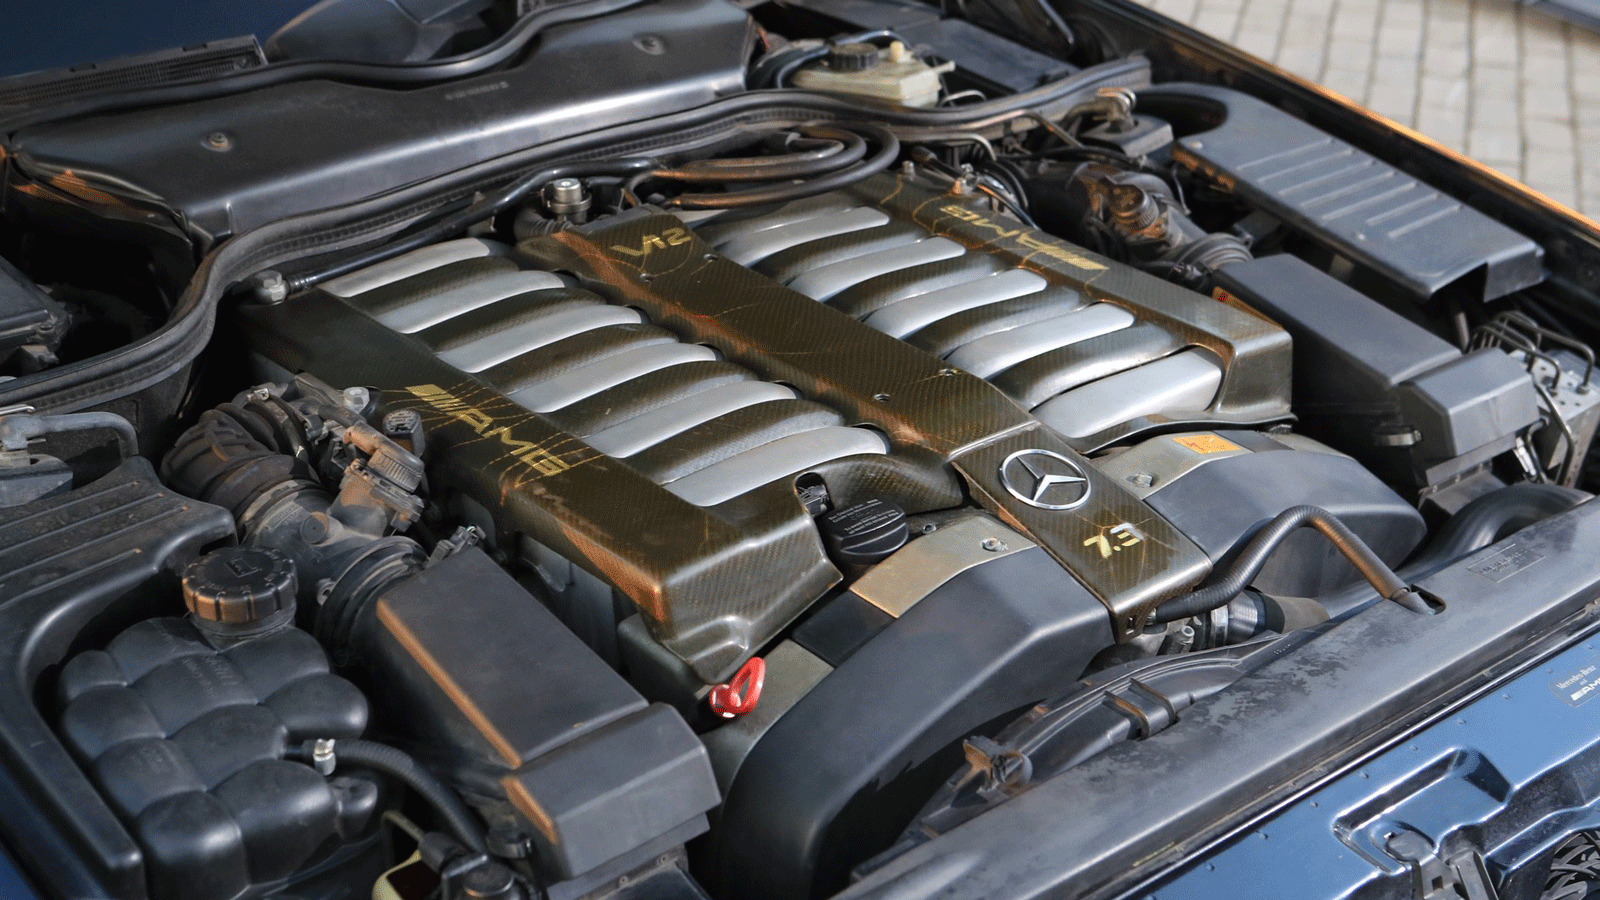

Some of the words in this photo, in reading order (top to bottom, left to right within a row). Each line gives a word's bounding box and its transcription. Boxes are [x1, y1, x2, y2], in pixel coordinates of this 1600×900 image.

[610, 227, 691, 256] V12
[940, 205, 1066, 257] AMG
[440, 403, 570, 476] AMG
[1083, 522, 1144, 559] 7.3
